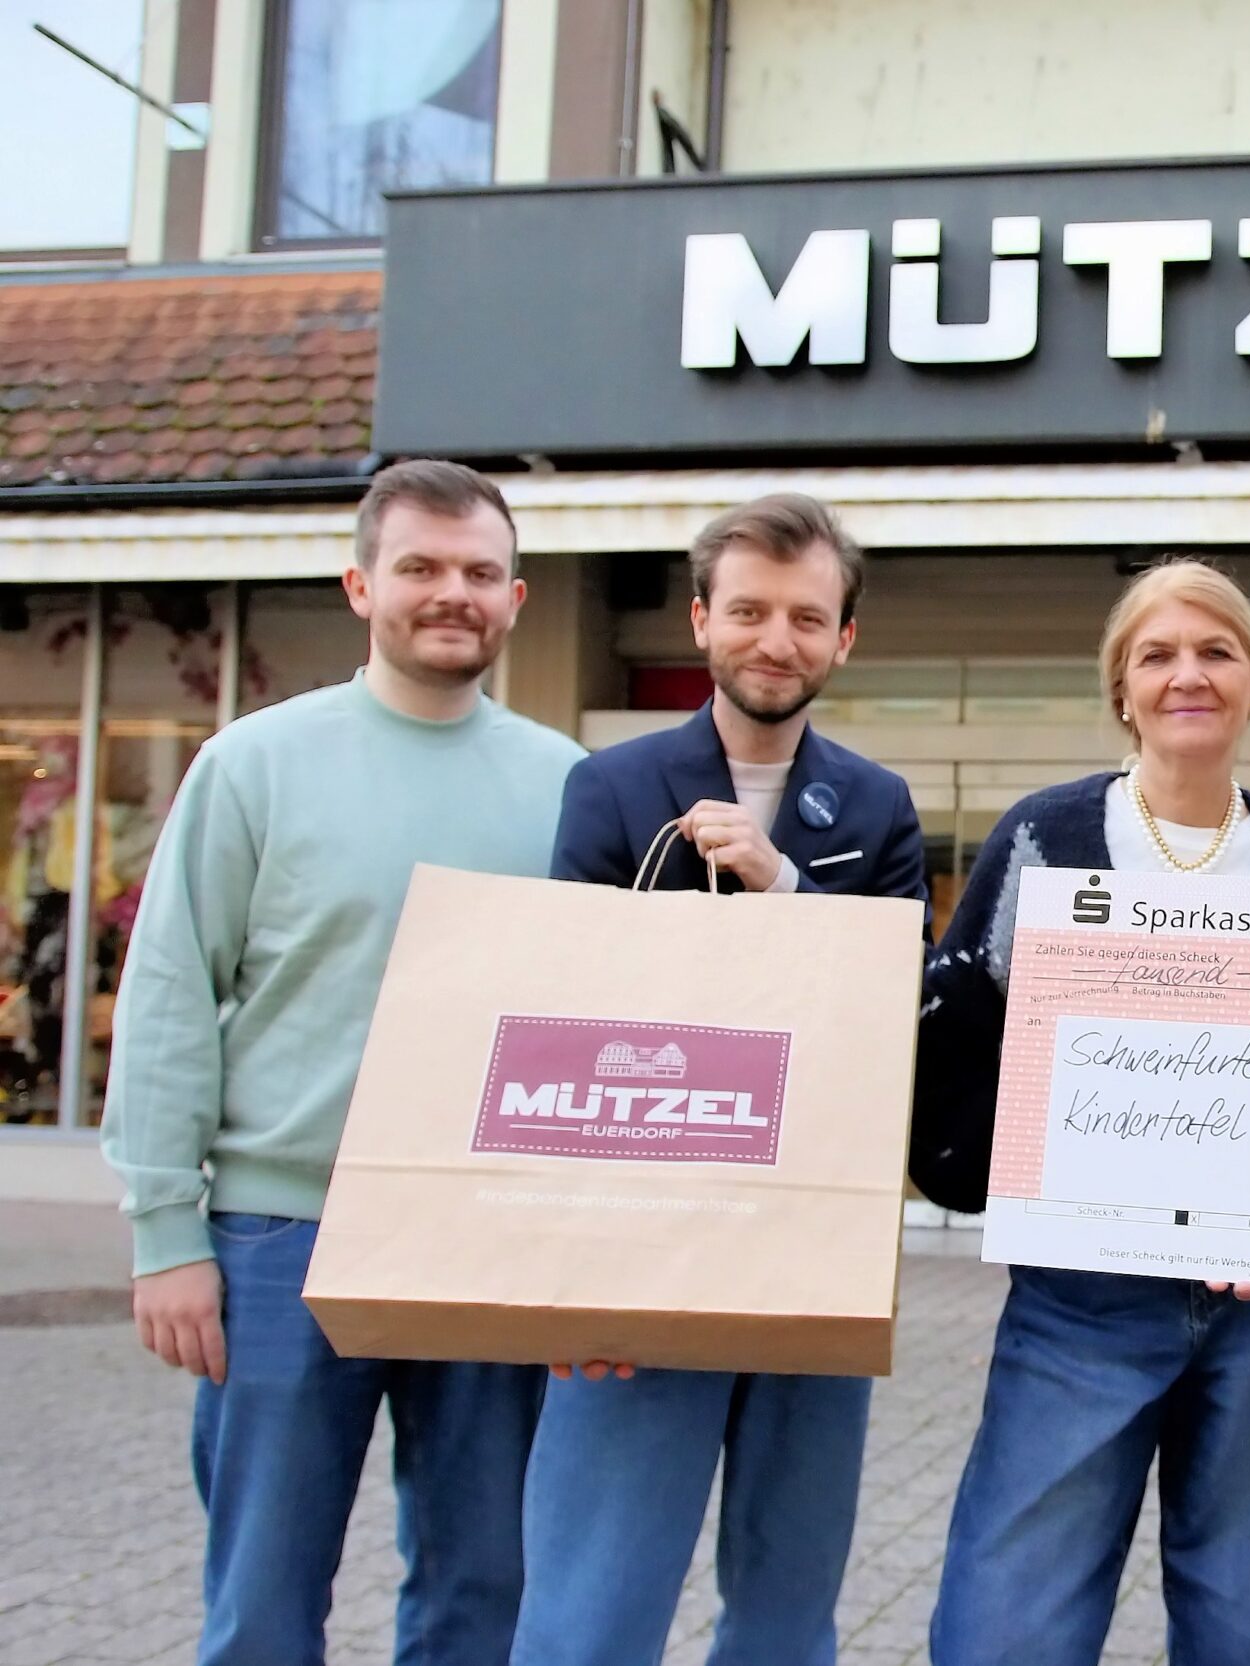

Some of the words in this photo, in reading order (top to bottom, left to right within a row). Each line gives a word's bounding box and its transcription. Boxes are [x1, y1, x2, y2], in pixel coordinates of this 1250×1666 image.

[1035, 943, 1074, 956] Zahlen
[1077, 946, 1095, 957] Sie
[1098, 949, 1134, 960] gegen
[1138, 949, 1176, 961] diesen
[1180, 951, 1220, 963] Scheck
[1030, 995, 1045, 1004] Nur
[1048, 993, 1061, 1001] zur
[1063, 985, 1119, 999] Verrechnung
[1132, 987, 1161, 997] Betrag
[1163, 988, 1171, 996] in
[1174, 989, 1226, 1000] Buchstaben
[1027, 1017, 1042, 1027] an
[498, 1082, 768, 1127] MÜTZEL
[1064, 1089, 1247, 1145] Kindertafel
[581, 1124, 684, 1139] EUERDORF
[1076, 1206, 1125, 1218] Scheck-Nr.
[1099, 1247, 1130, 1259] Dieser
[1133, 1250, 1165, 1262] Scheck
[1168, 1253, 1184, 1264] gilt
[1187, 1256, 1203, 1264] nur
[1205, 1256, 1219, 1265] für
